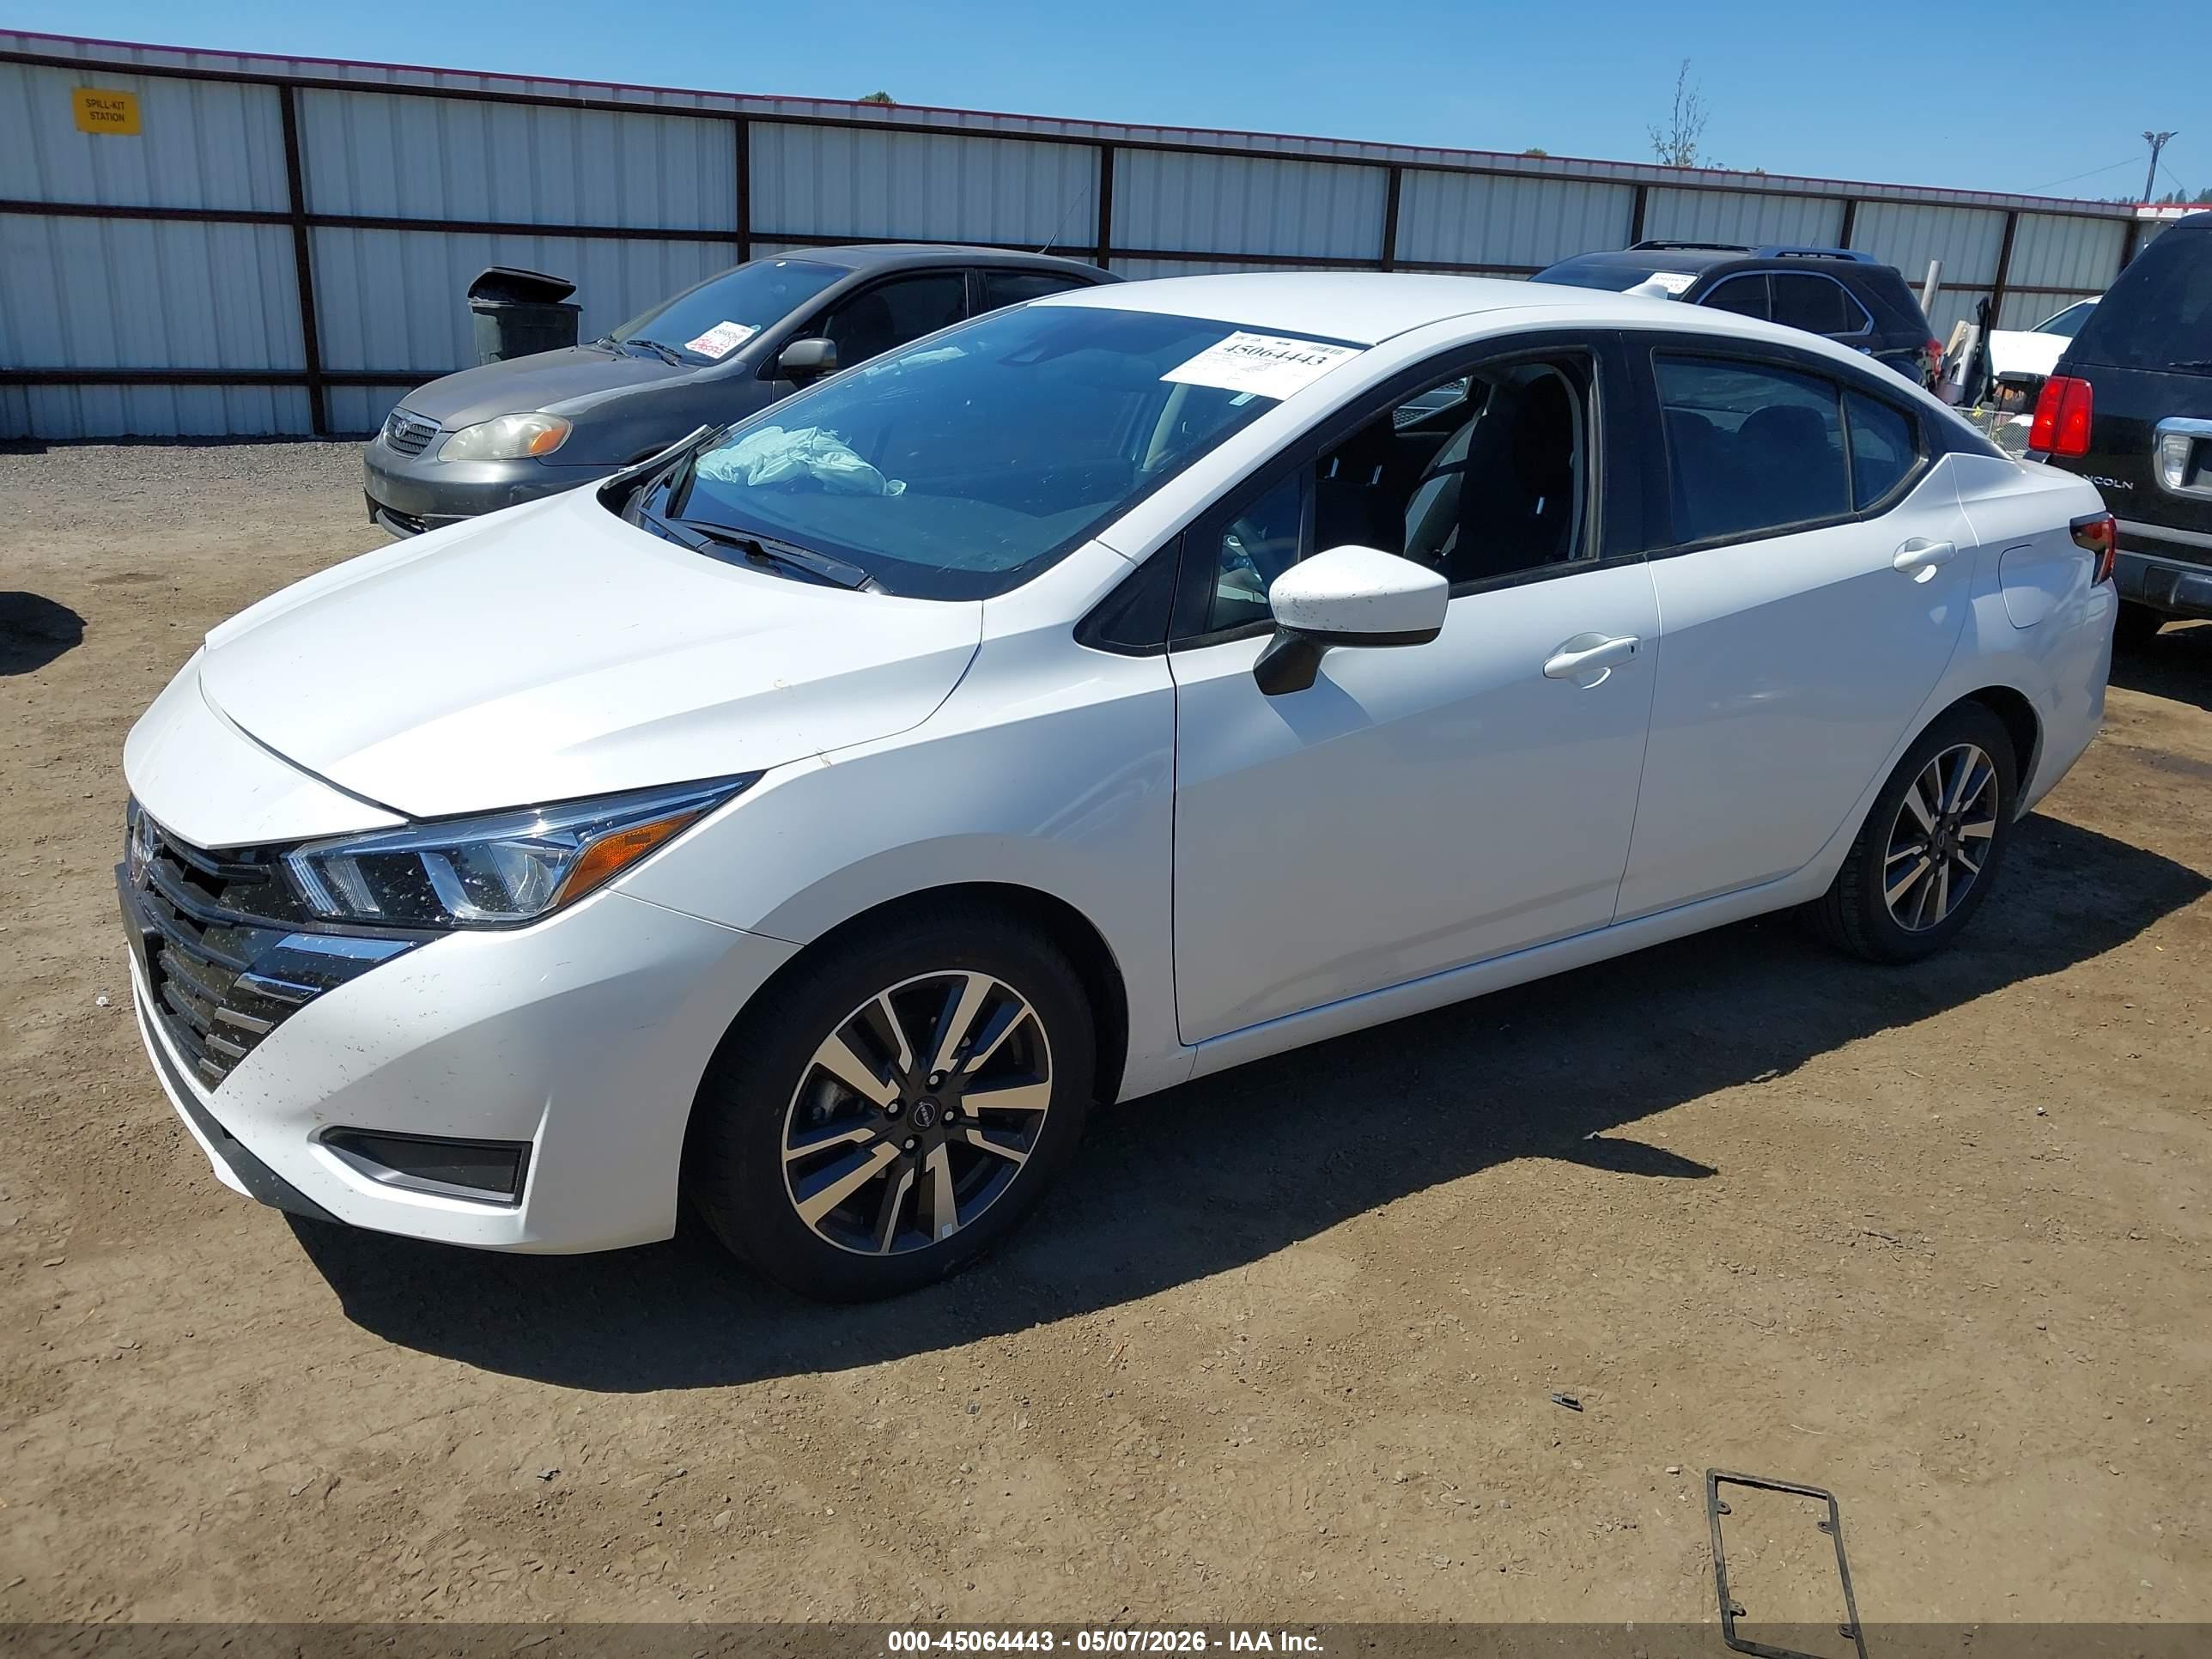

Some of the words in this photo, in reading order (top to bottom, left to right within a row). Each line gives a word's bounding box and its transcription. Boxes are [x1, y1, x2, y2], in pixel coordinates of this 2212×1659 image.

[85, 98, 125, 110] SPILL-KIT
[90, 112, 125, 122] STATION
[1223, 343, 1328, 366] 45064443
[2082, 473, 2134, 490] NCOLN
